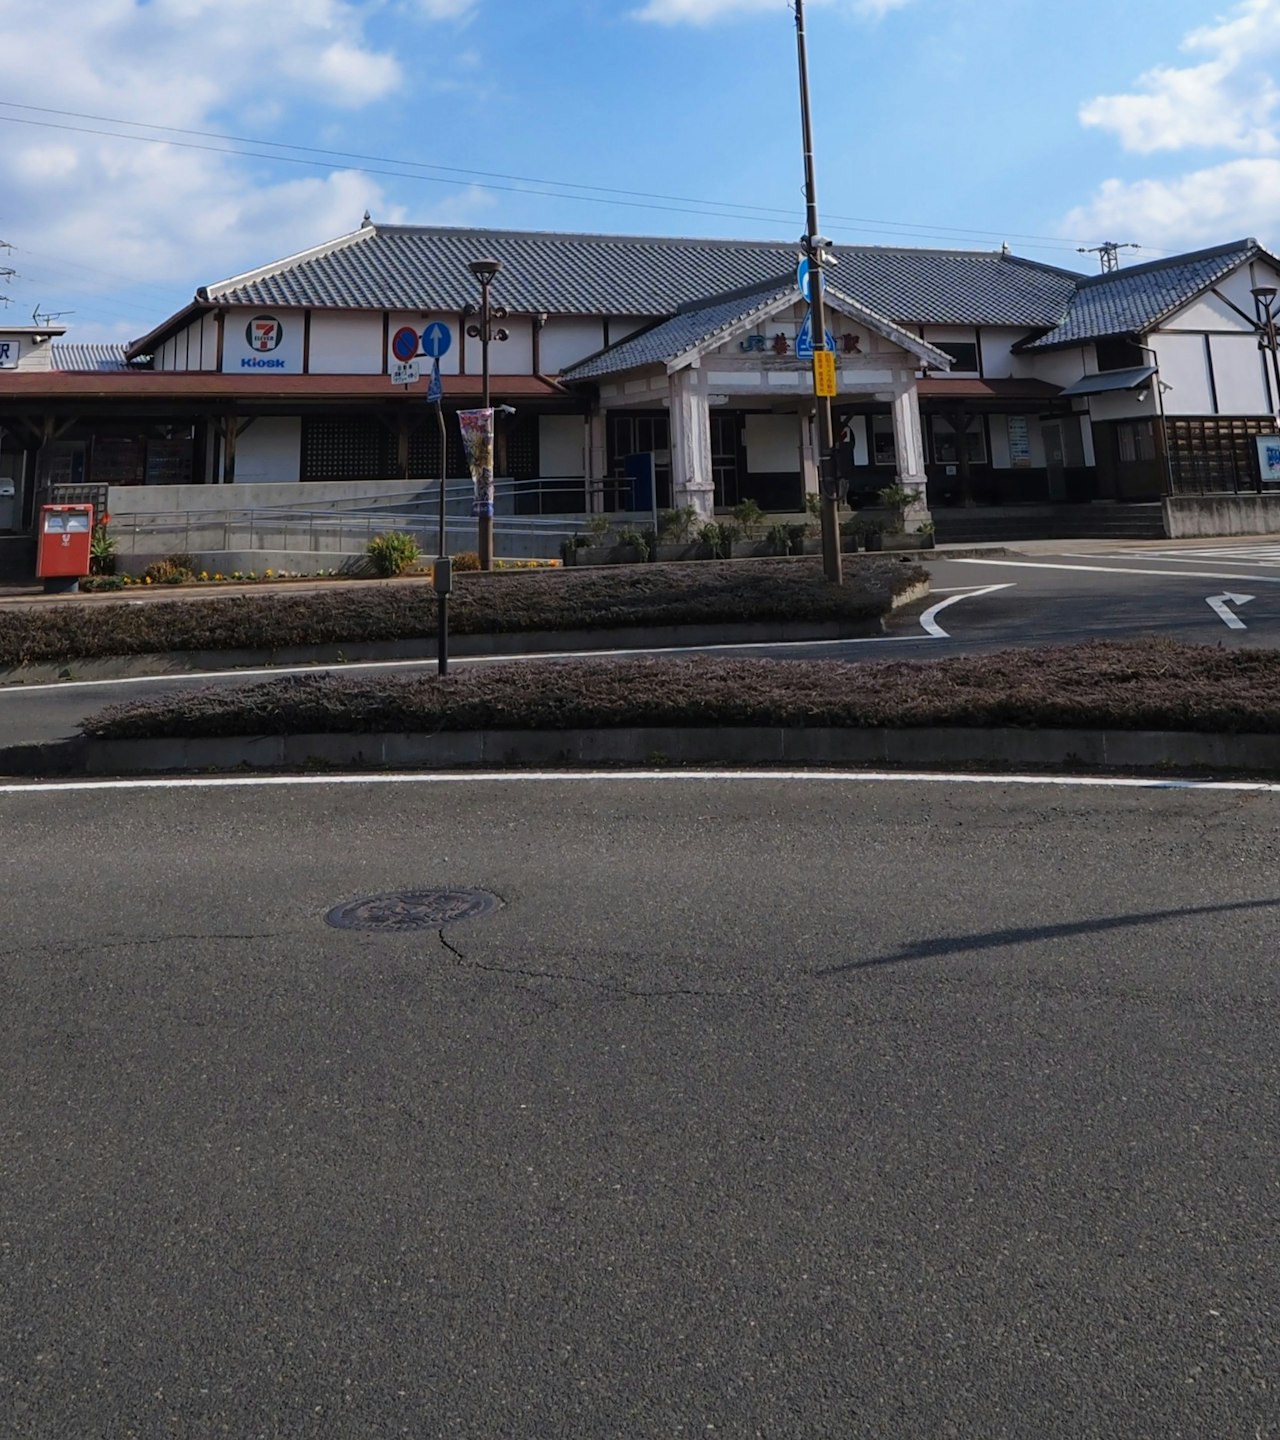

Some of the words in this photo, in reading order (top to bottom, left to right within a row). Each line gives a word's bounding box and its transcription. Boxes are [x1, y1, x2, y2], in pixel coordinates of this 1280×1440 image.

[256, 323, 274, 349] 7
[739, 335, 765, 352] JR
[241, 357, 285, 368] Kiosk
